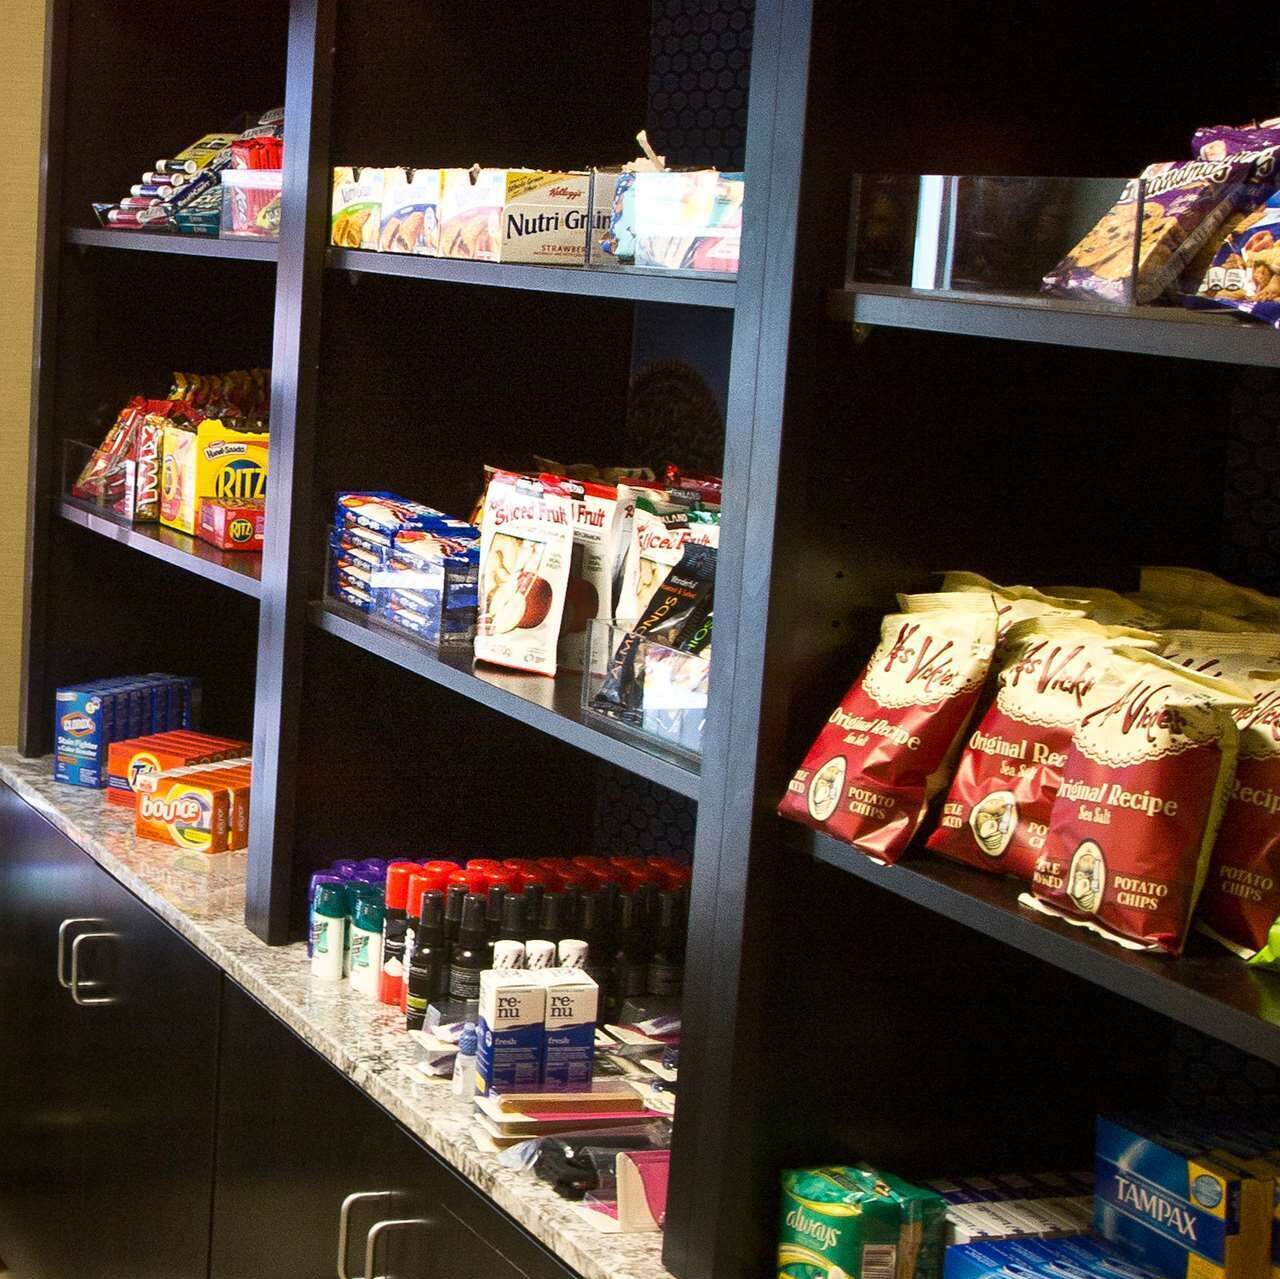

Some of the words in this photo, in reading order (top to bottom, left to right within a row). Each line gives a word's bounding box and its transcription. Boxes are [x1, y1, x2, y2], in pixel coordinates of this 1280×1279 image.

[506, 212, 560, 239] Nutri
[565, 210, 612, 231] Grin
[217, 465, 266, 499] RITZ
[576, 504, 606, 528] Fruit
[230, 521, 252, 539] RITZ
[610, 595, 679, 680] ALMONDS
[828, 706, 875, 733] Original
[870, 718, 921, 751] Recipe
[969, 730, 1026, 761] Original
[141, 792, 199, 822] bounce
[848, 785, 896, 809] POTATO
[1107, 783, 1178, 818] Recipe
[849, 801, 887, 820] CHIPS
[1077, 804, 1093, 822] Sea
[1093, 807, 1112, 825] Salt
[1113, 875, 1169, 896] POTATO
[1220, 864, 1275, 891] POTATO
[1116, 890, 1160, 911] CHIPS
[1221, 879, 1264, 902] CHIPS
[497, 1006, 521, 1019] nu
[550, 1006, 574, 1018] nu
[494, 1037, 518, 1046] fresh
[547, 1036, 570, 1045] fresh
[1114, 1175, 1198, 1241] TAMPAX
[785, 1205, 843, 1251] always
